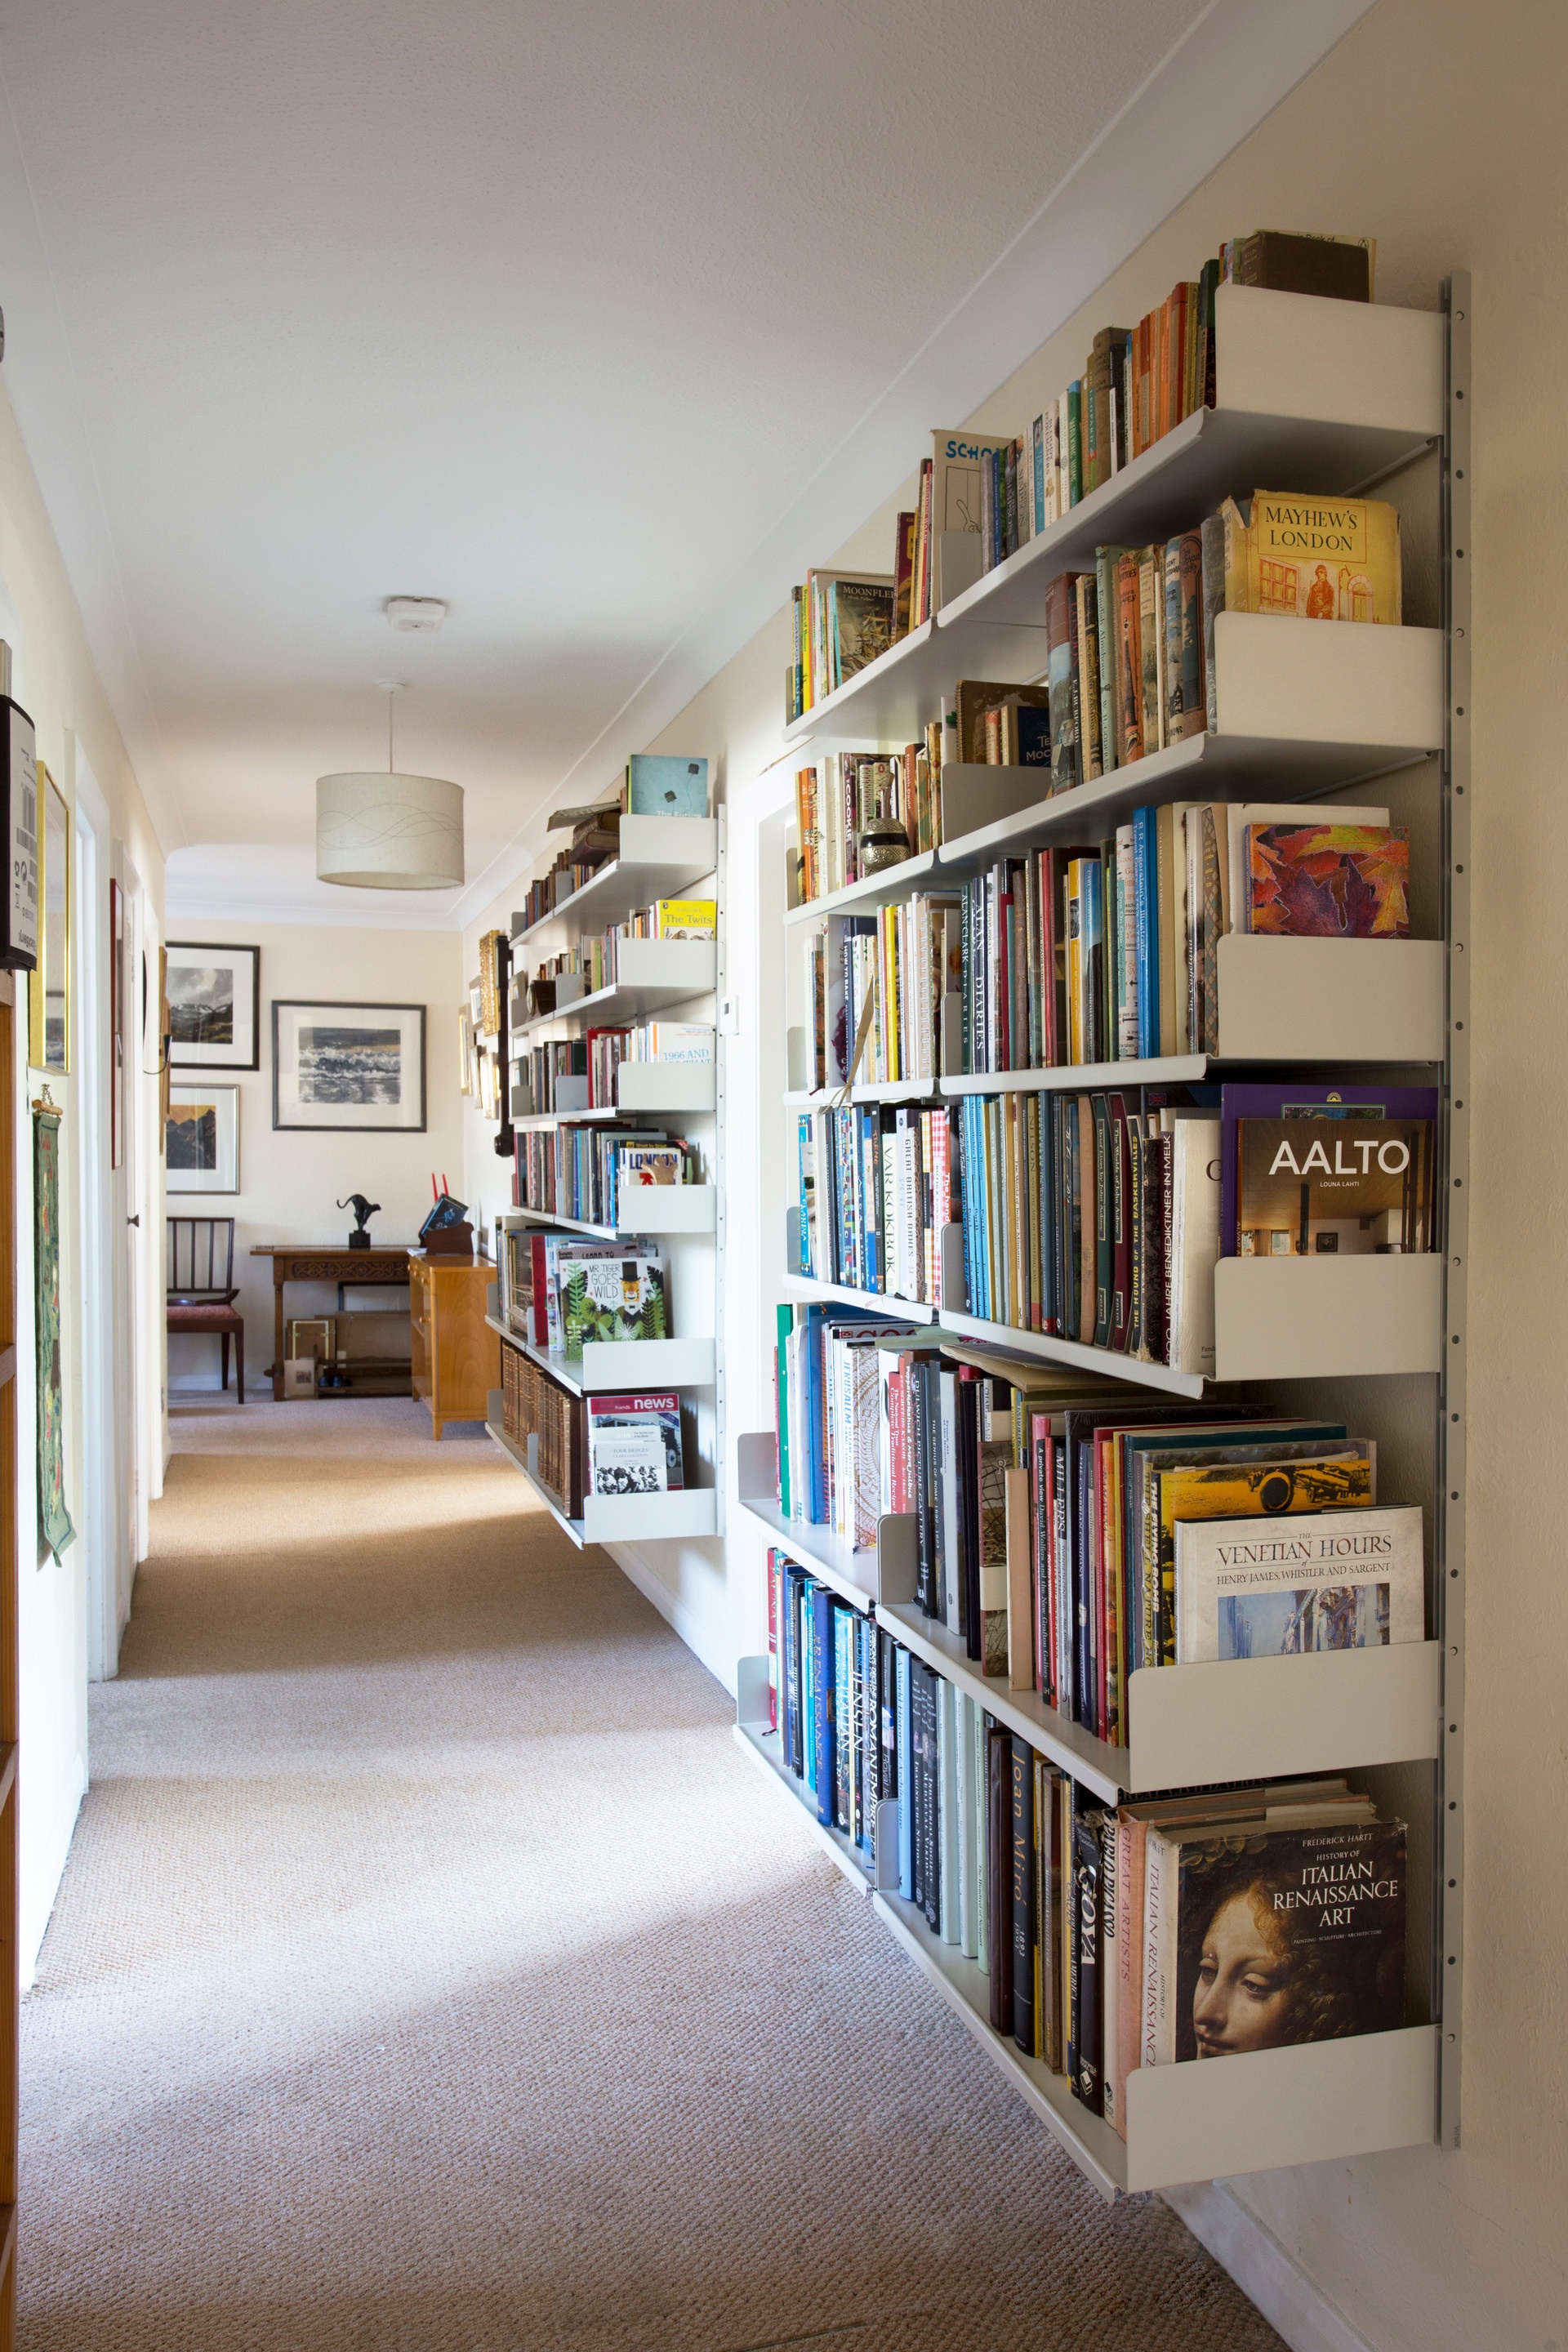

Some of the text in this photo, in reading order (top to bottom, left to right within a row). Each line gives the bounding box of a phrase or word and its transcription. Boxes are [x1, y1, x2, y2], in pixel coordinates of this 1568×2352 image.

[945, 439, 1004, 461] SCHO
[1068, 416, 1076, 462] WALKING
[1018, 469, 1027, 528] SIMPSON
[1266, 506, 1358, 530] MAYHEW'S
[1270, 529, 1353, 551] LONDON
[1069, 600, 1080, 668] LONDON
[1096, 566, 1108, 680] The English Almshouse
[664, 914, 713, 924] The Twits
[961, 926, 969, 964] CLARK
[975, 904, 985, 1050] ALAN DIARIES
[663, 1049, 710, 1061] 1966 AND
[1028, 1115, 1036, 1173] NELSON
[1162, 1134, 1171, 1169] MELK
[1268, 1140, 1410, 1175] AALTO
[1131, 1134, 1139, 1219] BASKERVILLES
[1163, 1172, 1171, 1186] IN
[903, 1138, 915, 1258] GREAT BRITISH BAKES
[884, 1190, 896, 1275] KOKBOK
[1163, 1188, 1173, 1278] BENEDIKTINER
[589, 1263, 621, 1273] MR TIGER
[1134, 1249, 1139, 1262] OF
[591, 1273, 619, 1285] GOES
[594, 1285, 618, 1298] WILD
[634, 1397, 675, 1410] news
[843, 1360, 852, 1424] JERUSALEM
[1055, 1454, 1067, 1533] MILLER'S
[1144, 1472, 1152, 1504] THE
[1150, 1481, 1160, 1613] THE FLYING BOMB
[1216, 1535, 1392, 1566] VENETIAN HOURS
[1298, 1532, 1312, 1540] THE
[1216, 1561, 1391, 1586] HENRY JAMES, WHISTLER AND SARGENT
[1300, 1559, 1307, 1569] of
[1143, 1571, 1153, 1637] NATURE
[839, 1684, 850, 1753] ITALIAN
[867, 1699, 878, 1828] ROMAN EMPIRE
[1011, 1748, 1028, 1908] Joan Miró
[1302, 1833, 1374, 1847] FREDERICK HARTT
[1316, 1850, 1361, 1862] HISTORY OF
[1102, 1824, 1116, 1940] PABLO PICASSO
[1301, 1860, 1374, 1886] ITALIAN
[1121, 1826, 1131, 1983] GREAT ARTISTS
[1148, 1863, 1160, 1939] ITALIAN
[1272, 1880, 1399, 1911] RENAISSANCE
[1318, 1906, 1355, 1928] ART
[1018, 1929, 1026, 1958] 1893
[1293, 1929, 1383, 1945] PAINTING SCULPTURE ARCHITECTURE
[1070, 1956, 1078, 2002] AMERICA
[1159, 2006, 1165, 2020] OF
